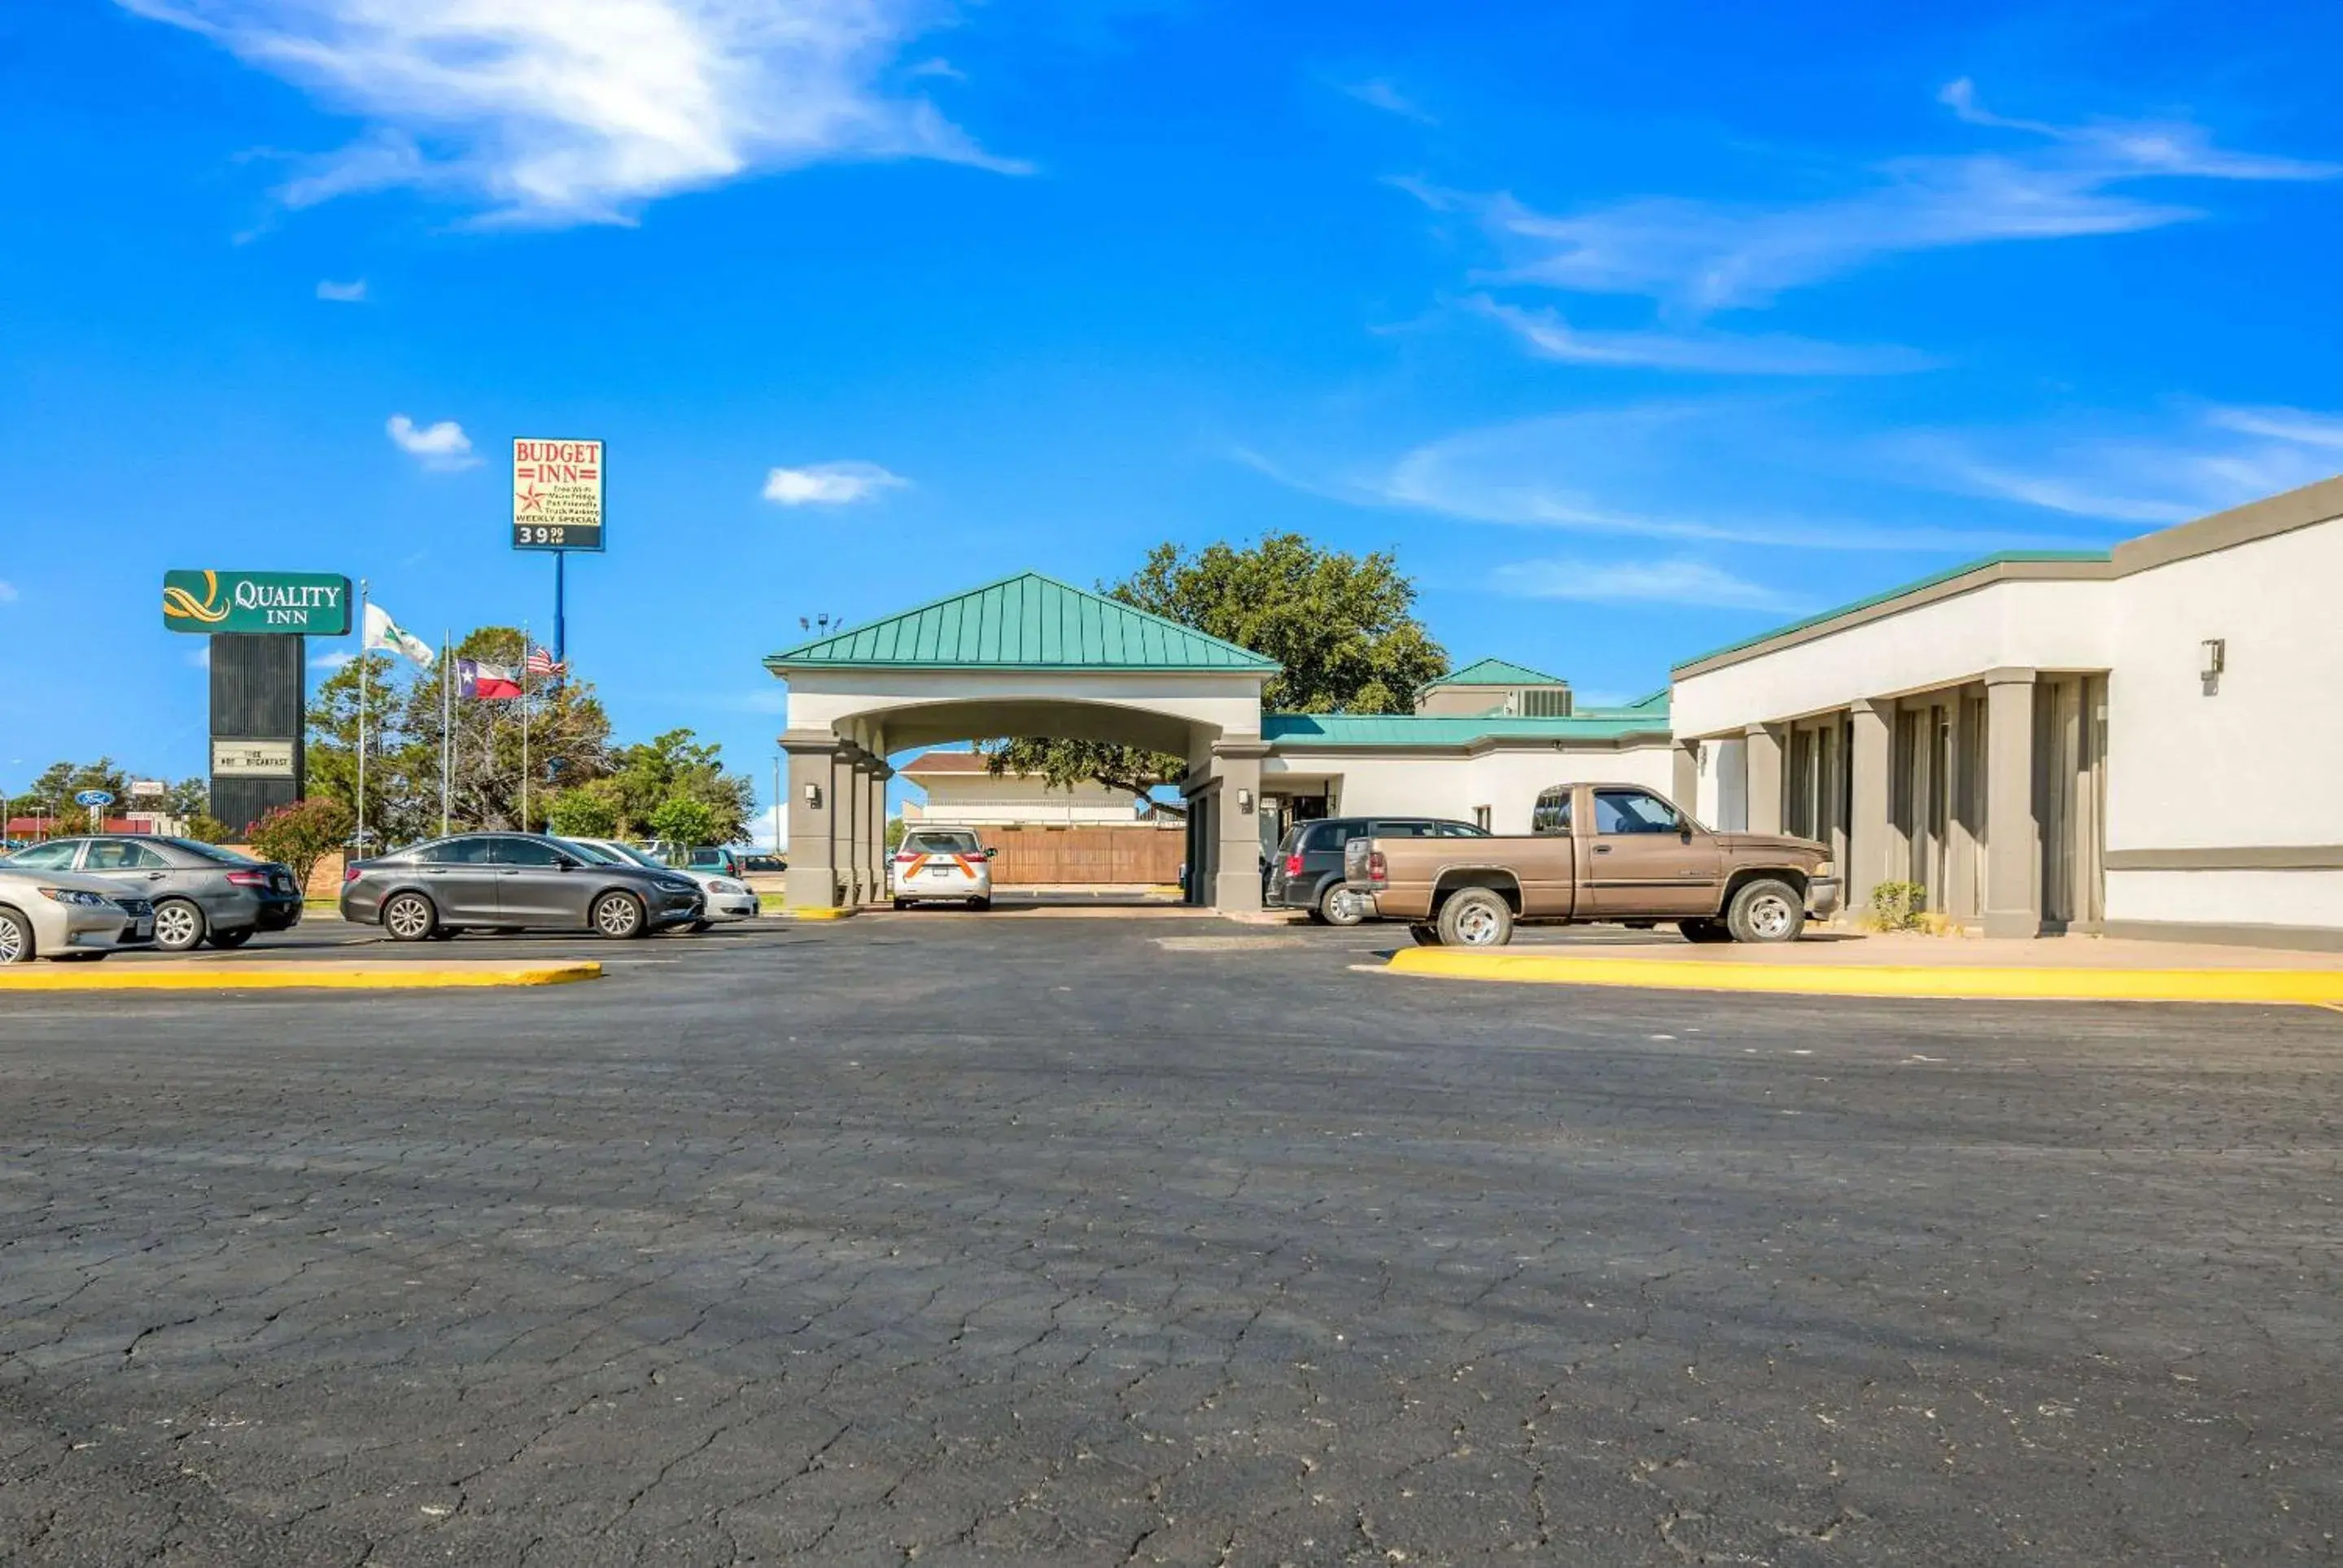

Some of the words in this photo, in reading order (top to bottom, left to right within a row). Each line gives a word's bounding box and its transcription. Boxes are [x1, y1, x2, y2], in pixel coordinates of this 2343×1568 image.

[517, 442, 599, 463] BUDGET
[538, 464, 578, 483] INN
[563, 500, 597, 509] Friendly
[516, 514, 555, 522] WEEKLY
[558, 515, 598, 523] SPECIAL
[569, 509, 600, 517] Parking
[267, 609, 308, 624] INN
